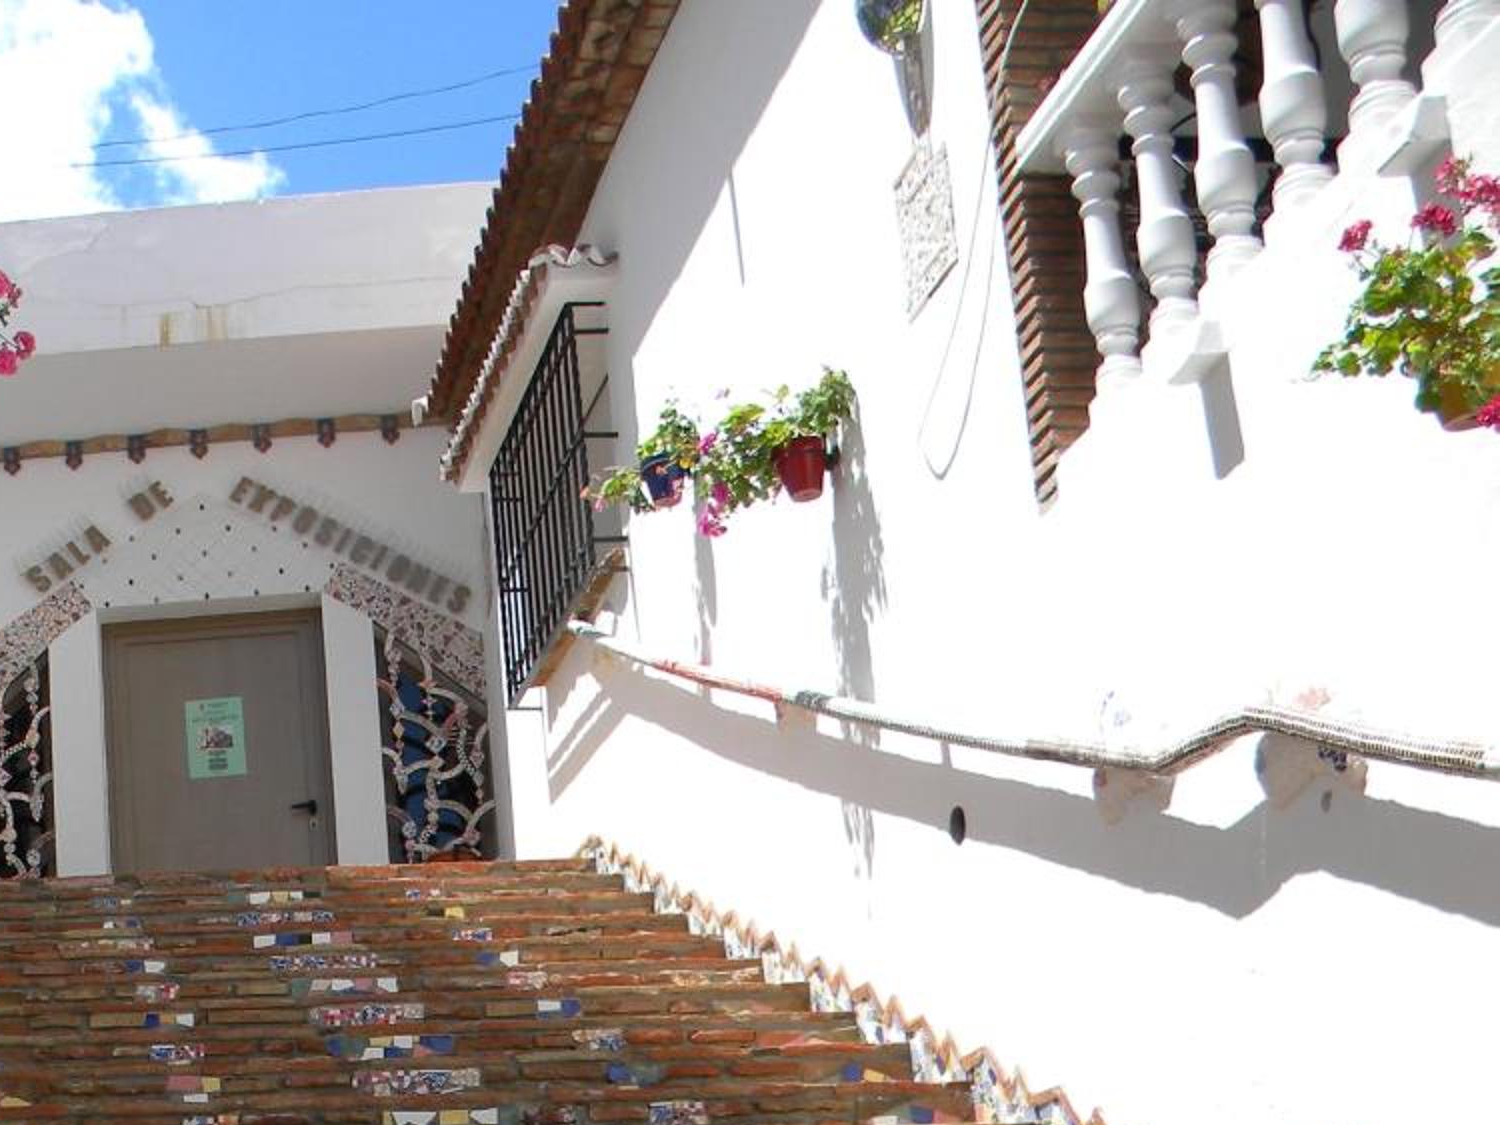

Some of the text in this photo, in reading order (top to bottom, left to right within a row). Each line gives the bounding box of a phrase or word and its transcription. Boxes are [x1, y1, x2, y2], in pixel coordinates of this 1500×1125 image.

[24, 476, 472, 614] SALA DE EXPOSICIONES
